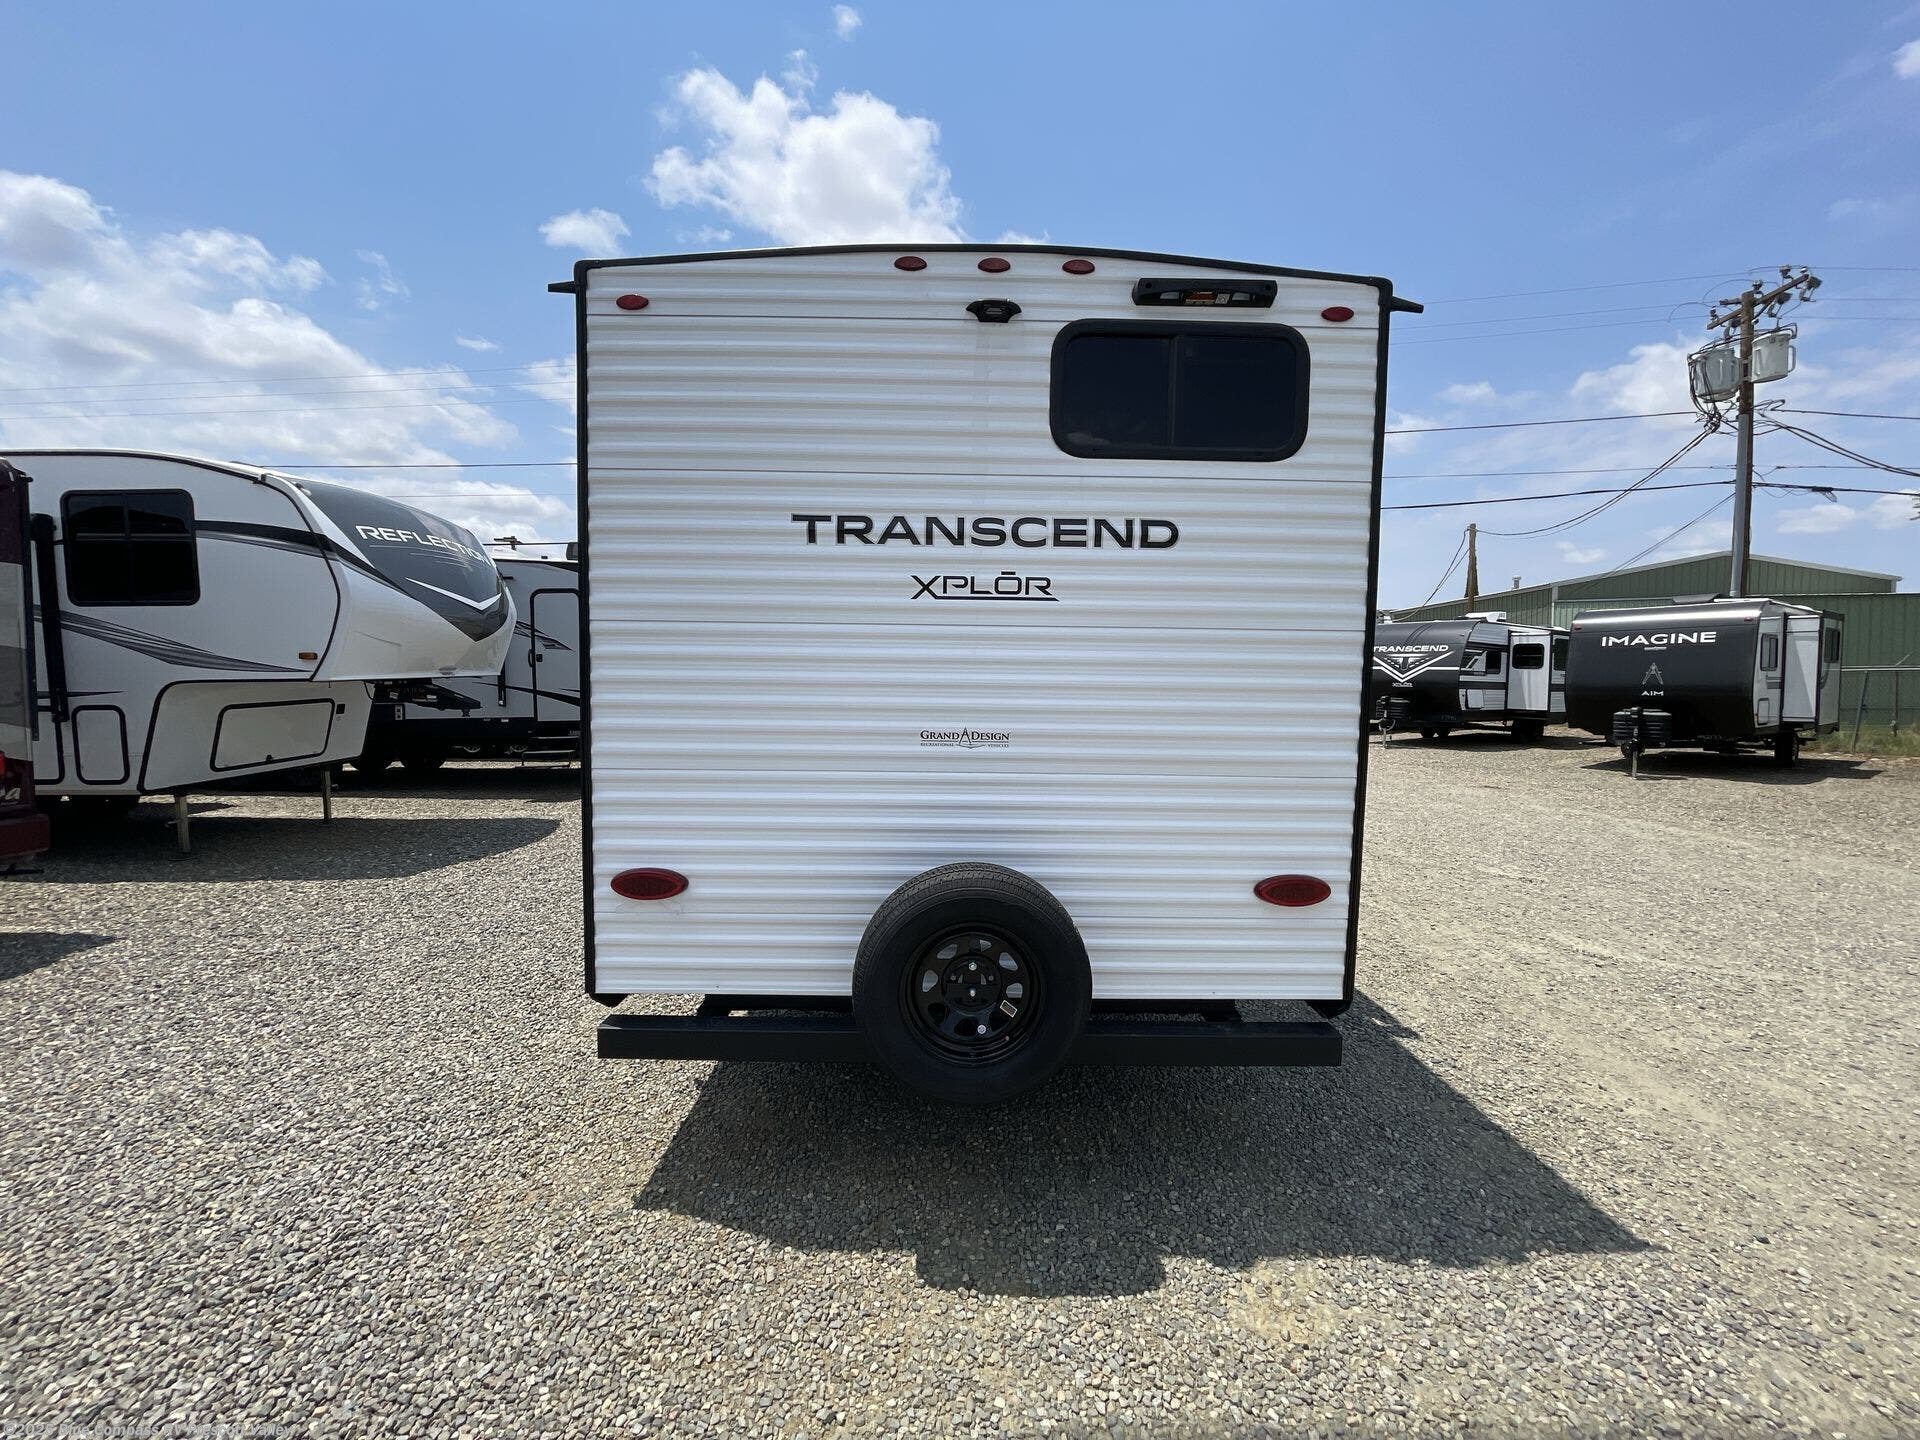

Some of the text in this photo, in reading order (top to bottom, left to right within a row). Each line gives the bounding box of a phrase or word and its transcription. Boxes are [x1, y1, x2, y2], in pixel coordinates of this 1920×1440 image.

[355, 525, 493, 567] REFLECTION
[791, 513, 1180, 549] TRANSCEND
[1601, 631, 1717, 647] IMAGINE
